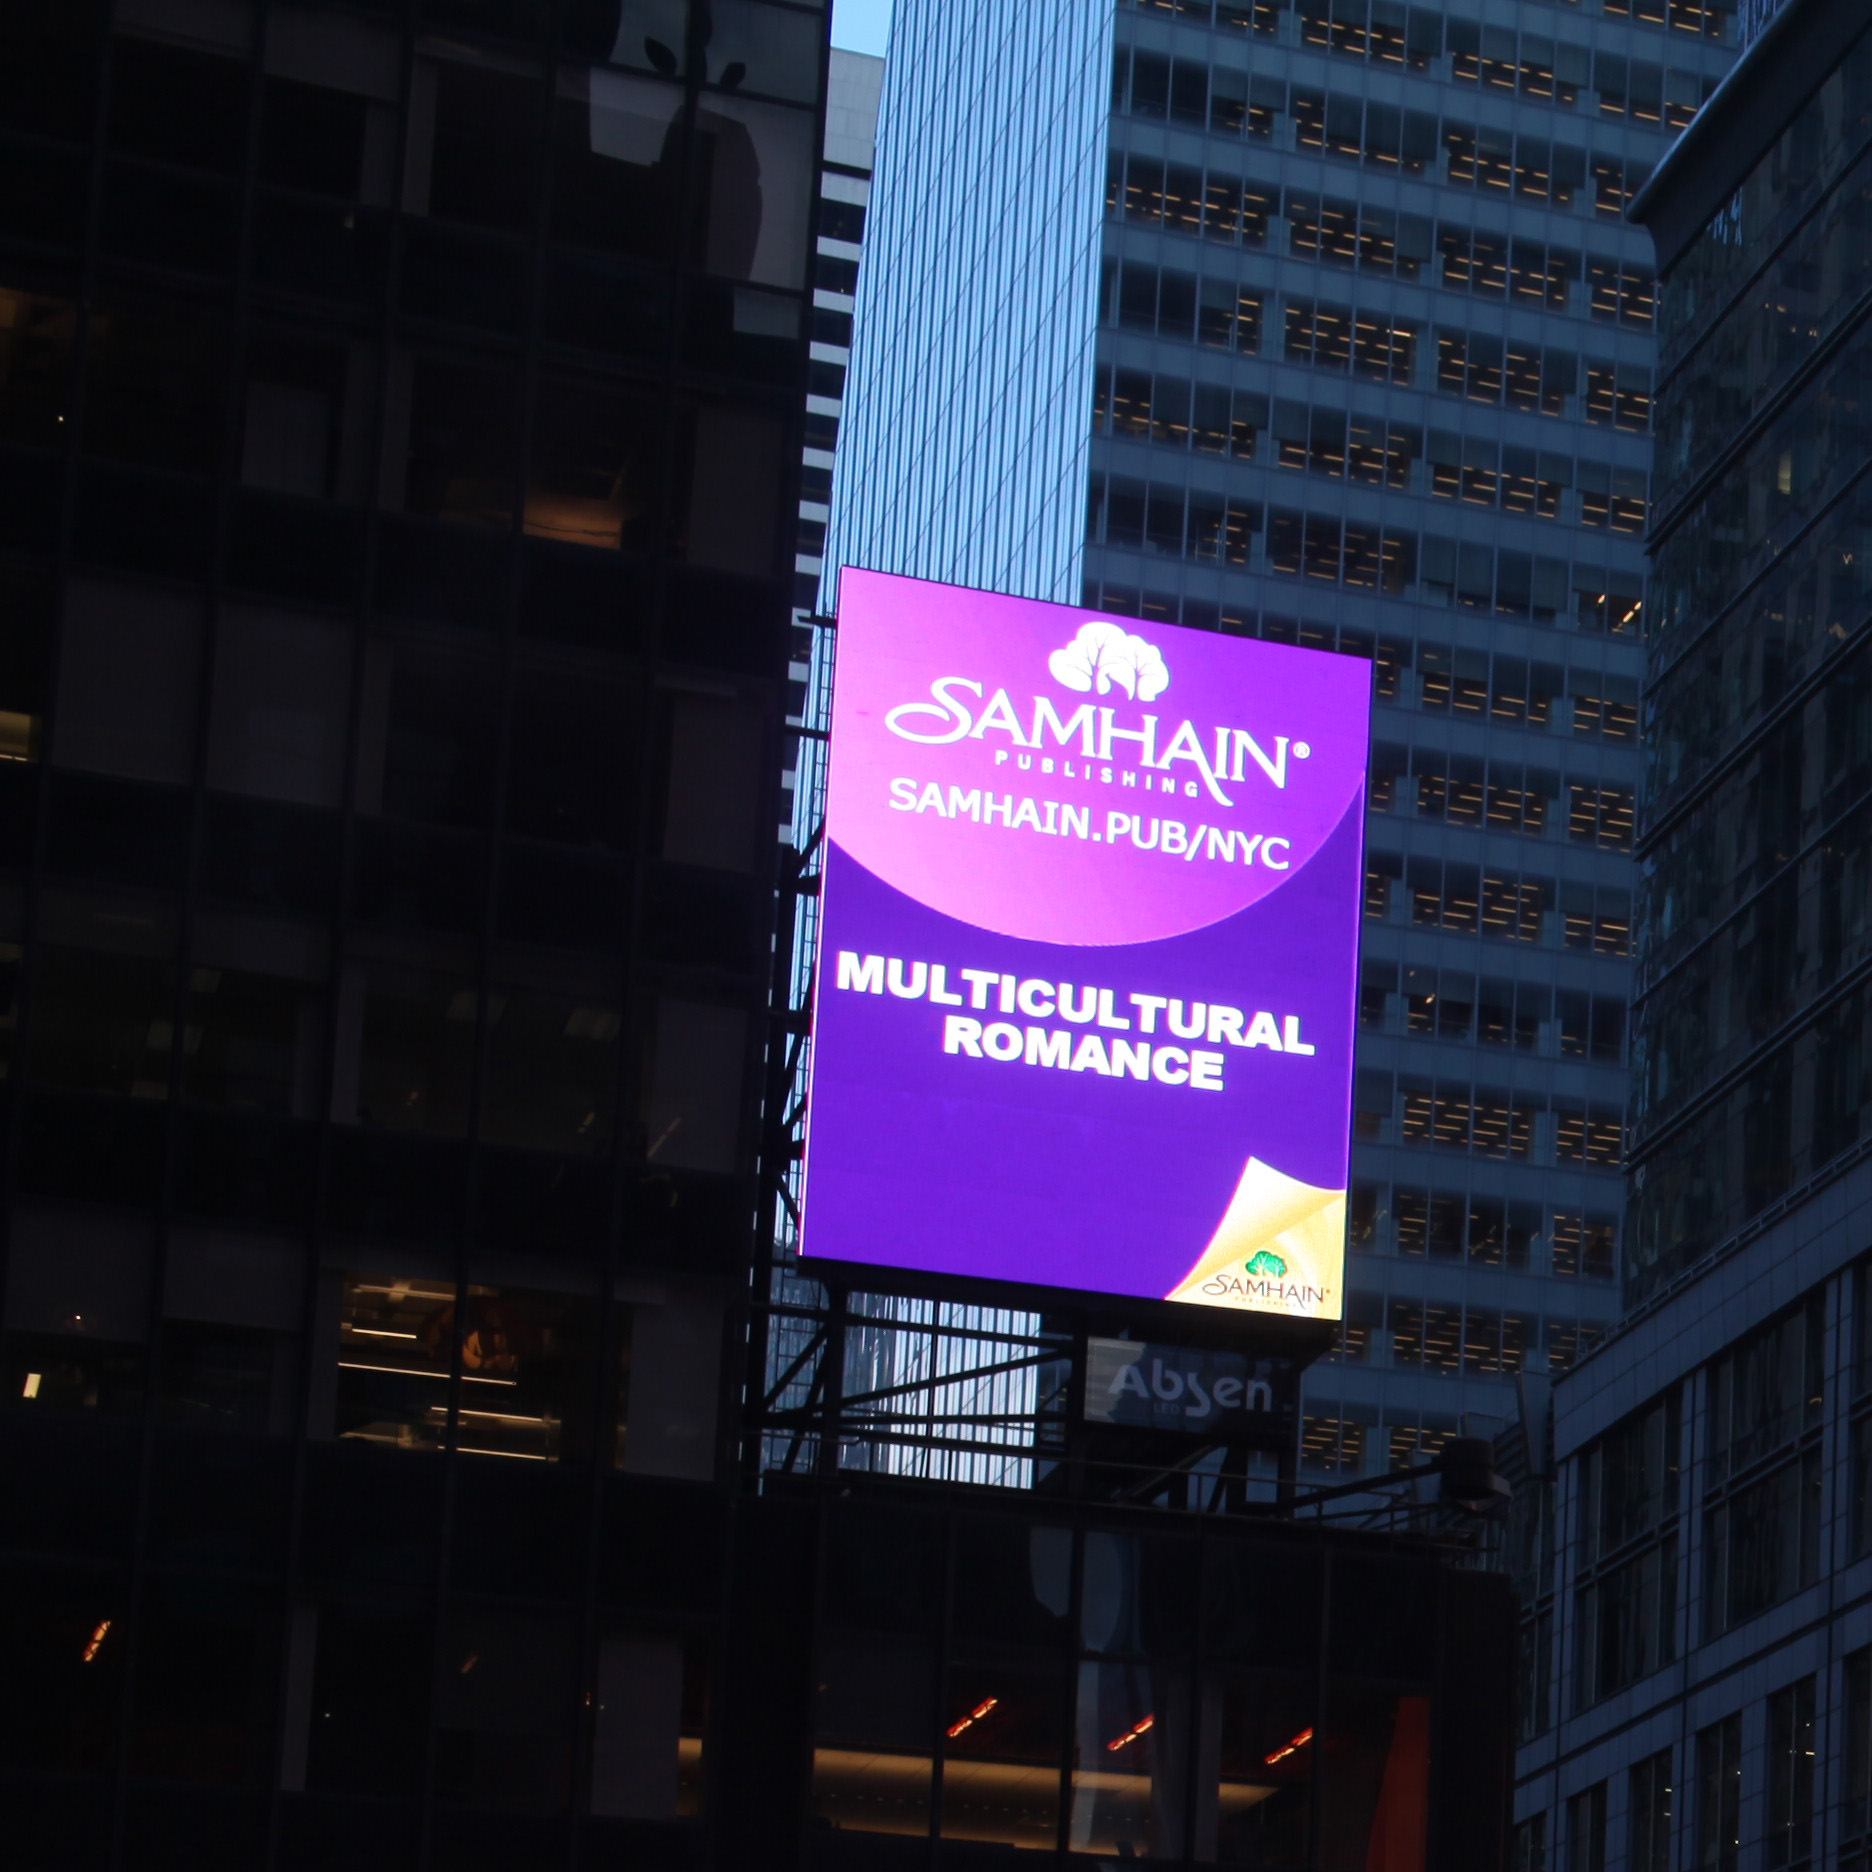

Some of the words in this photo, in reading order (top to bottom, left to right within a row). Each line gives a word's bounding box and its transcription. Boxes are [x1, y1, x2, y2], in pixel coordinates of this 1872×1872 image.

[995, 749, 1199, 799] PUBLISHING
[889, 777, 1291, 870] SAMHAIN.PUB/NYC
[835, 950, 1315, 1057] MULTICULTURAL
[944, 1016, 1224, 1092] ROMANCE
[1108, 1355, 1273, 1418] Absen
